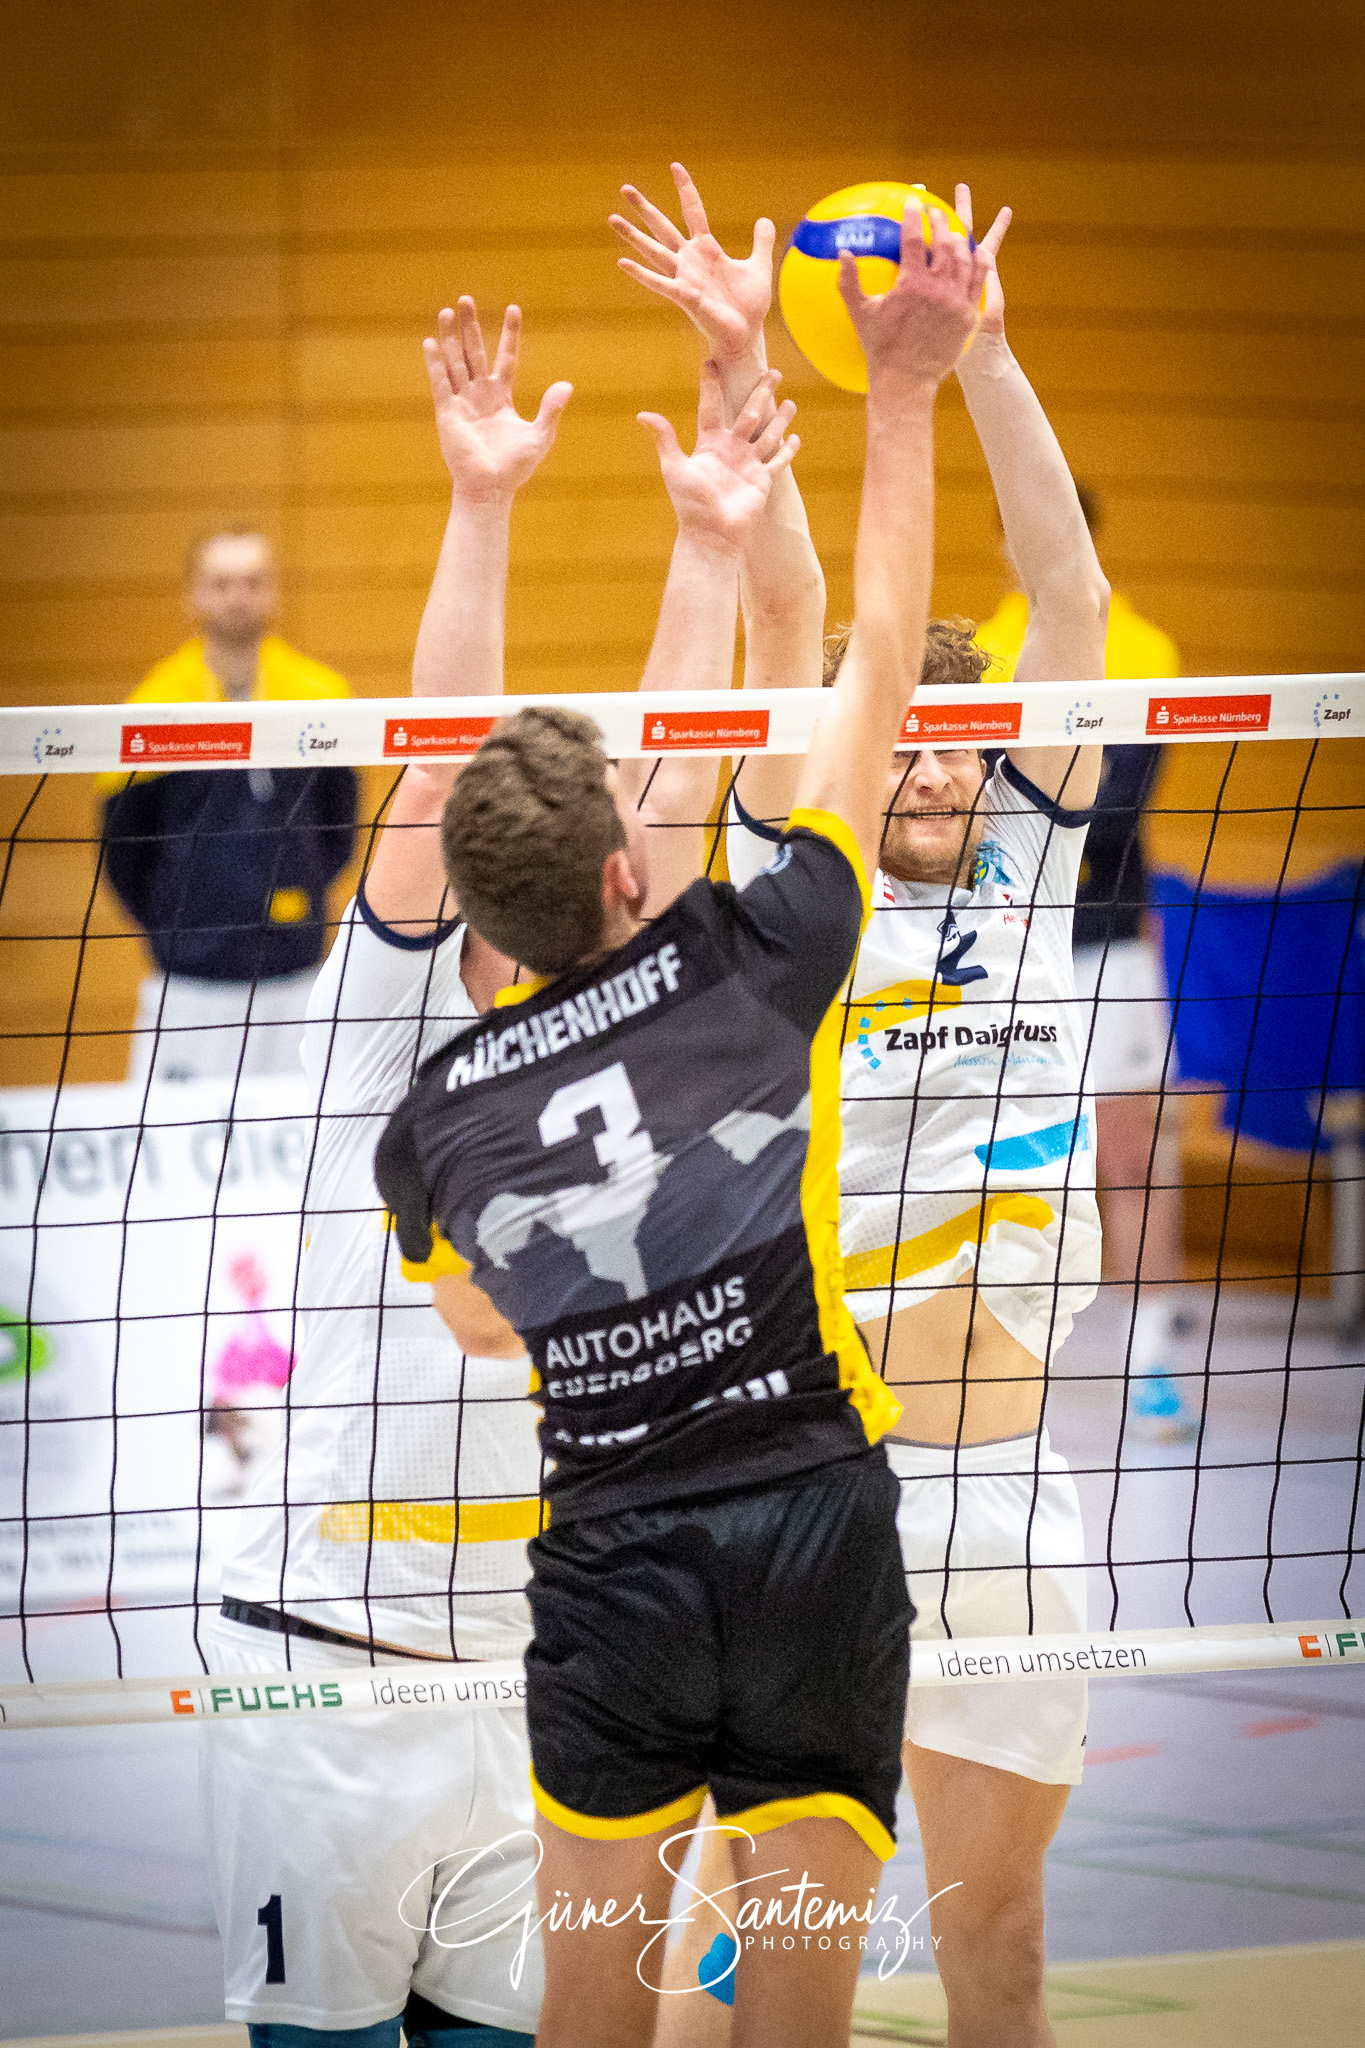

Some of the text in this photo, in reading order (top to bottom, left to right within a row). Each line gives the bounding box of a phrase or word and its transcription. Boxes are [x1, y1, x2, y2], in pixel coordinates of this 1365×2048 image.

[1172, 713, 1218, 725] Sparkasse
[1219, 712, 1262, 723] Nürnberg
[1324, 708, 1352, 721] Zapf
[922, 721, 969, 734] Sparkasse
[969, 720, 1012, 732] Nürnberg
[1076, 716, 1104, 729] Zapf
[411, 735, 458, 747] Sparkasse
[668, 728, 716, 741] Sparkasse
[716, 727, 760, 740] Nürnberg
[44, 743, 75, 758] Zapf
[147, 740, 195, 754] Sparkasse
[197, 739, 244, 752] Nürnberg
[309, 737, 338, 751] Zapf
[884, 1026, 949, 1055] Zapf
[538, 1062, 657, 1232] 3
[546, 1275, 747, 1369] AUTOHAUS
[1336, 1632, 1365, 1657] F
[937, 1645, 1147, 1677] Ideen umsetzen
[210, 1683, 343, 1713] FUCHS
[370, 1677, 445, 1705] Ideen
[257, 1894, 286, 1985] 1
